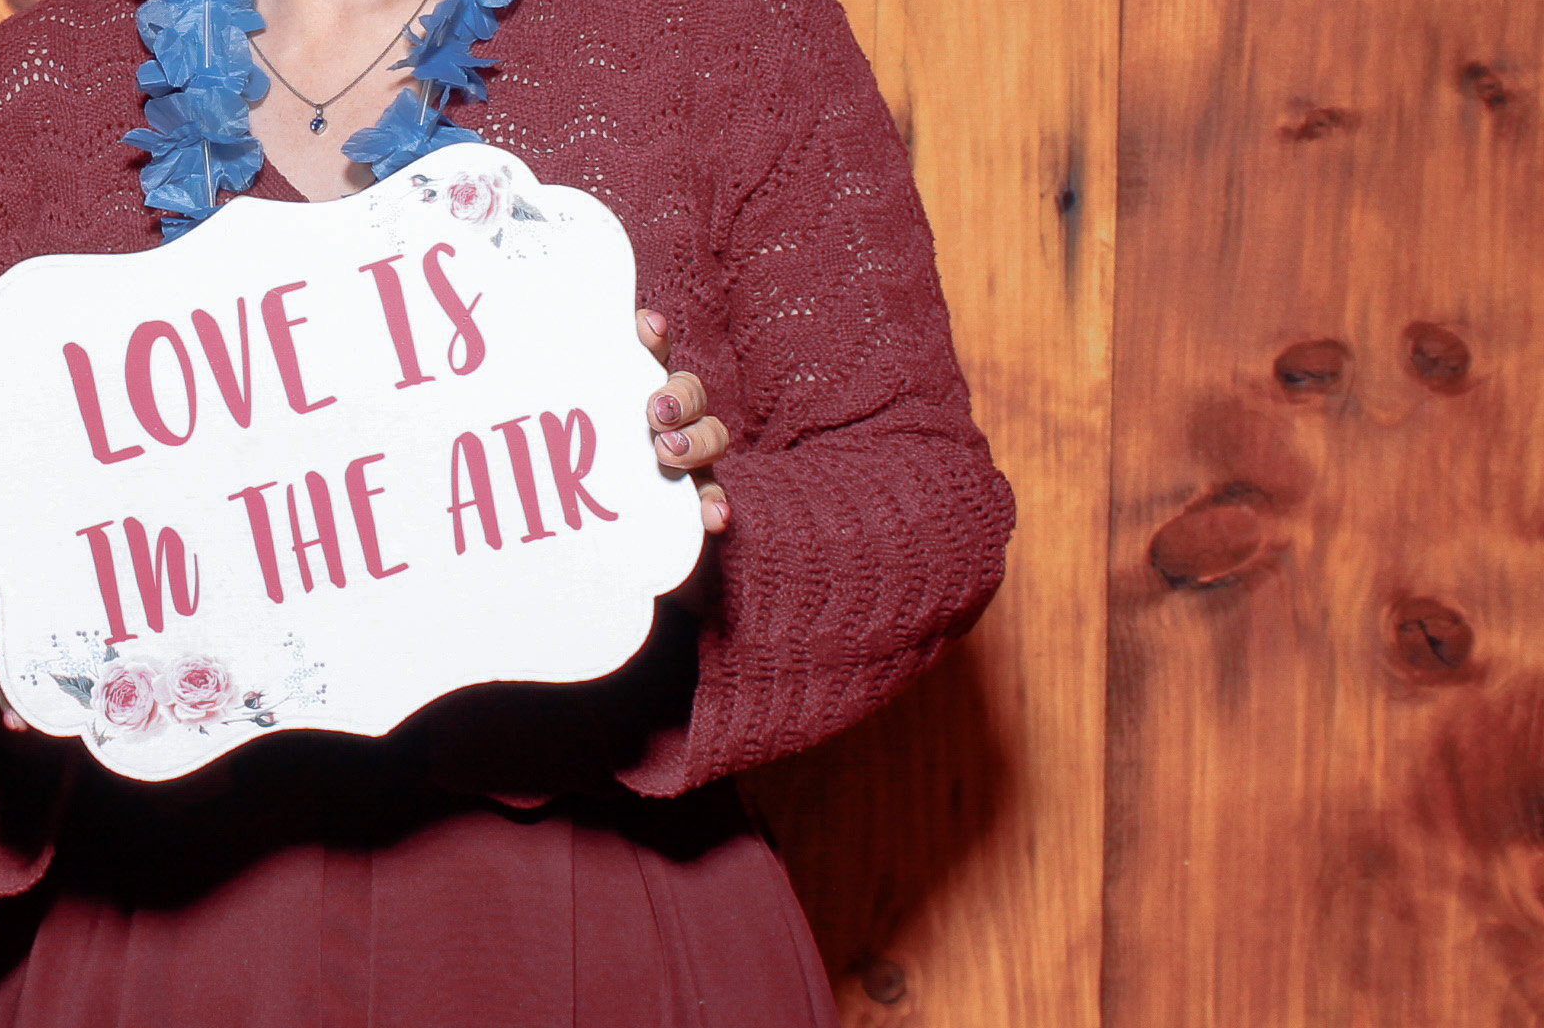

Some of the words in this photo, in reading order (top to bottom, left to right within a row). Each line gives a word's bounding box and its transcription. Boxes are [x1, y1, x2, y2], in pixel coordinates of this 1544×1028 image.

[61, 279, 338, 466] LOVE
[358, 241, 486, 390] IS
[226, 452, 410, 605] THE
[445, 406, 620, 557] AIR
